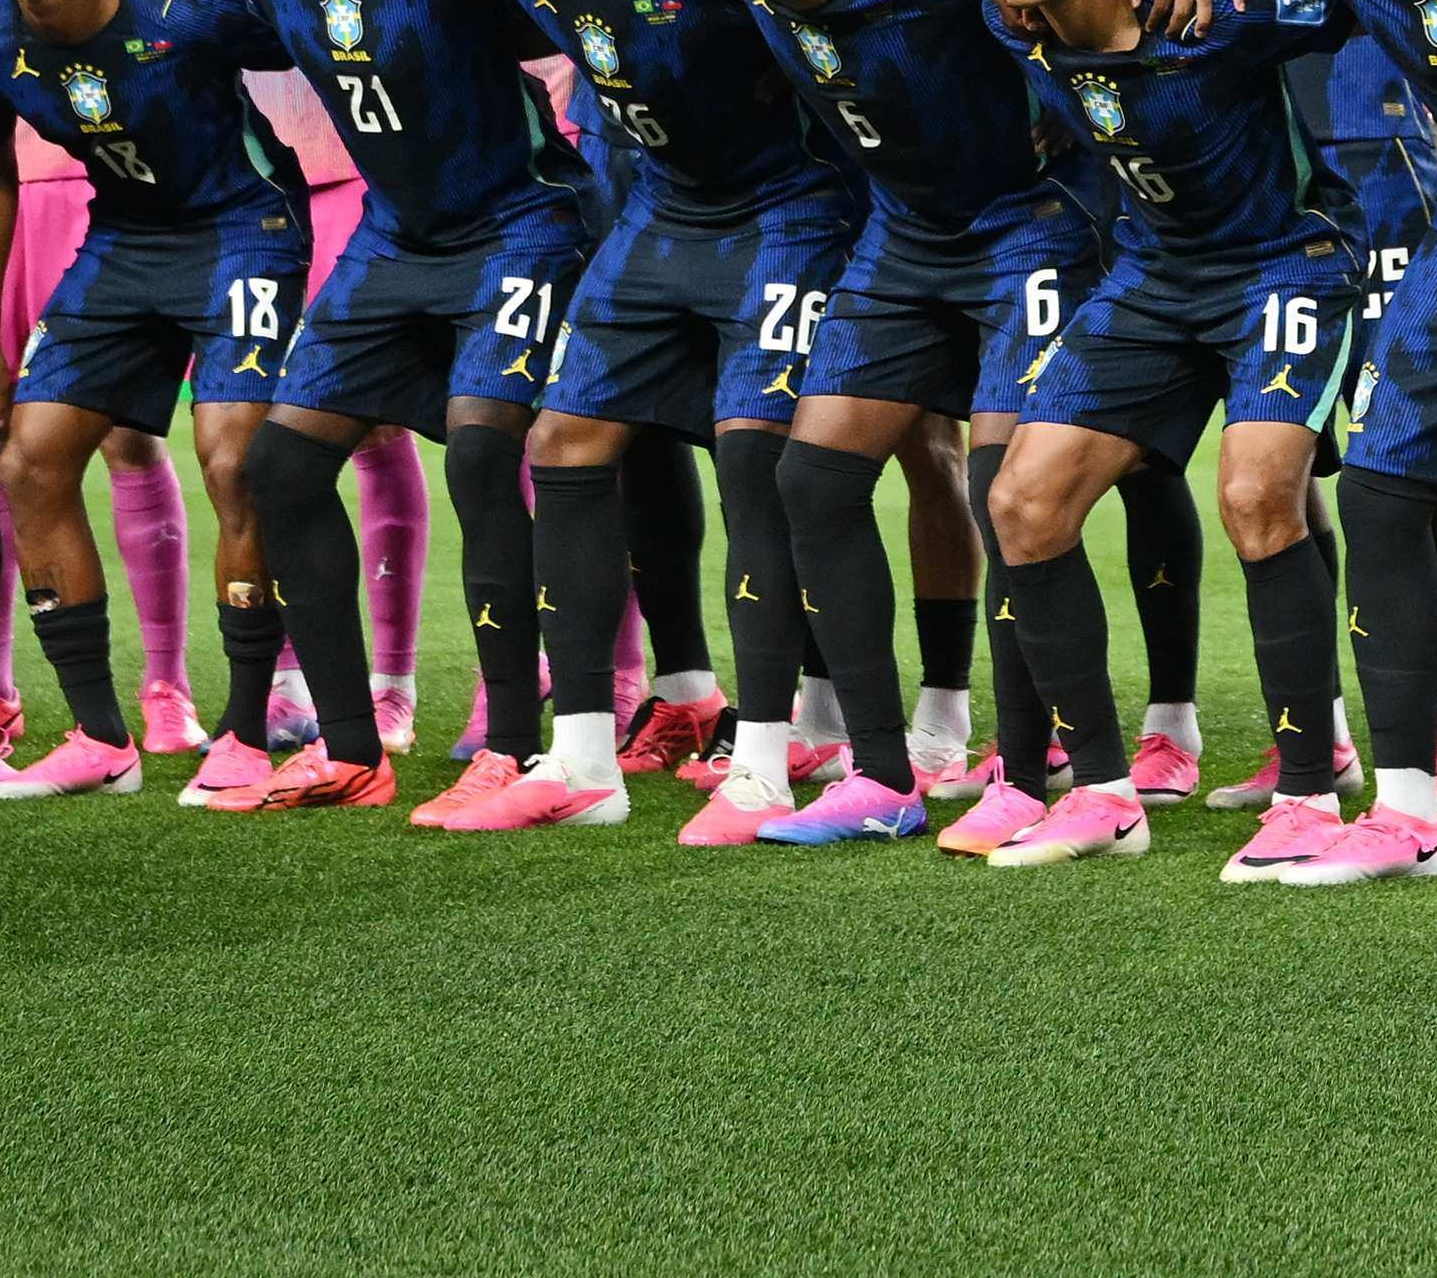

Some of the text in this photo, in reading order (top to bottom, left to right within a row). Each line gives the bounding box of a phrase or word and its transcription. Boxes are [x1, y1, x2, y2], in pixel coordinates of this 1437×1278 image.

[330, 49, 373, 63] BRASIL
[335, 73, 404, 134] 21
[592, 72, 633, 90] BRASIL
[79, 121, 124, 134] BRASIL
[836, 100, 882, 148] 6
[93, 139, 158, 185] 18
[1109, 154, 1176, 203] 16
[227, 277, 280, 341] 18
[494, 276, 554, 345] 21
[1025, 268, 1061, 337] 6
[1262, 292, 1318, 355] 16
